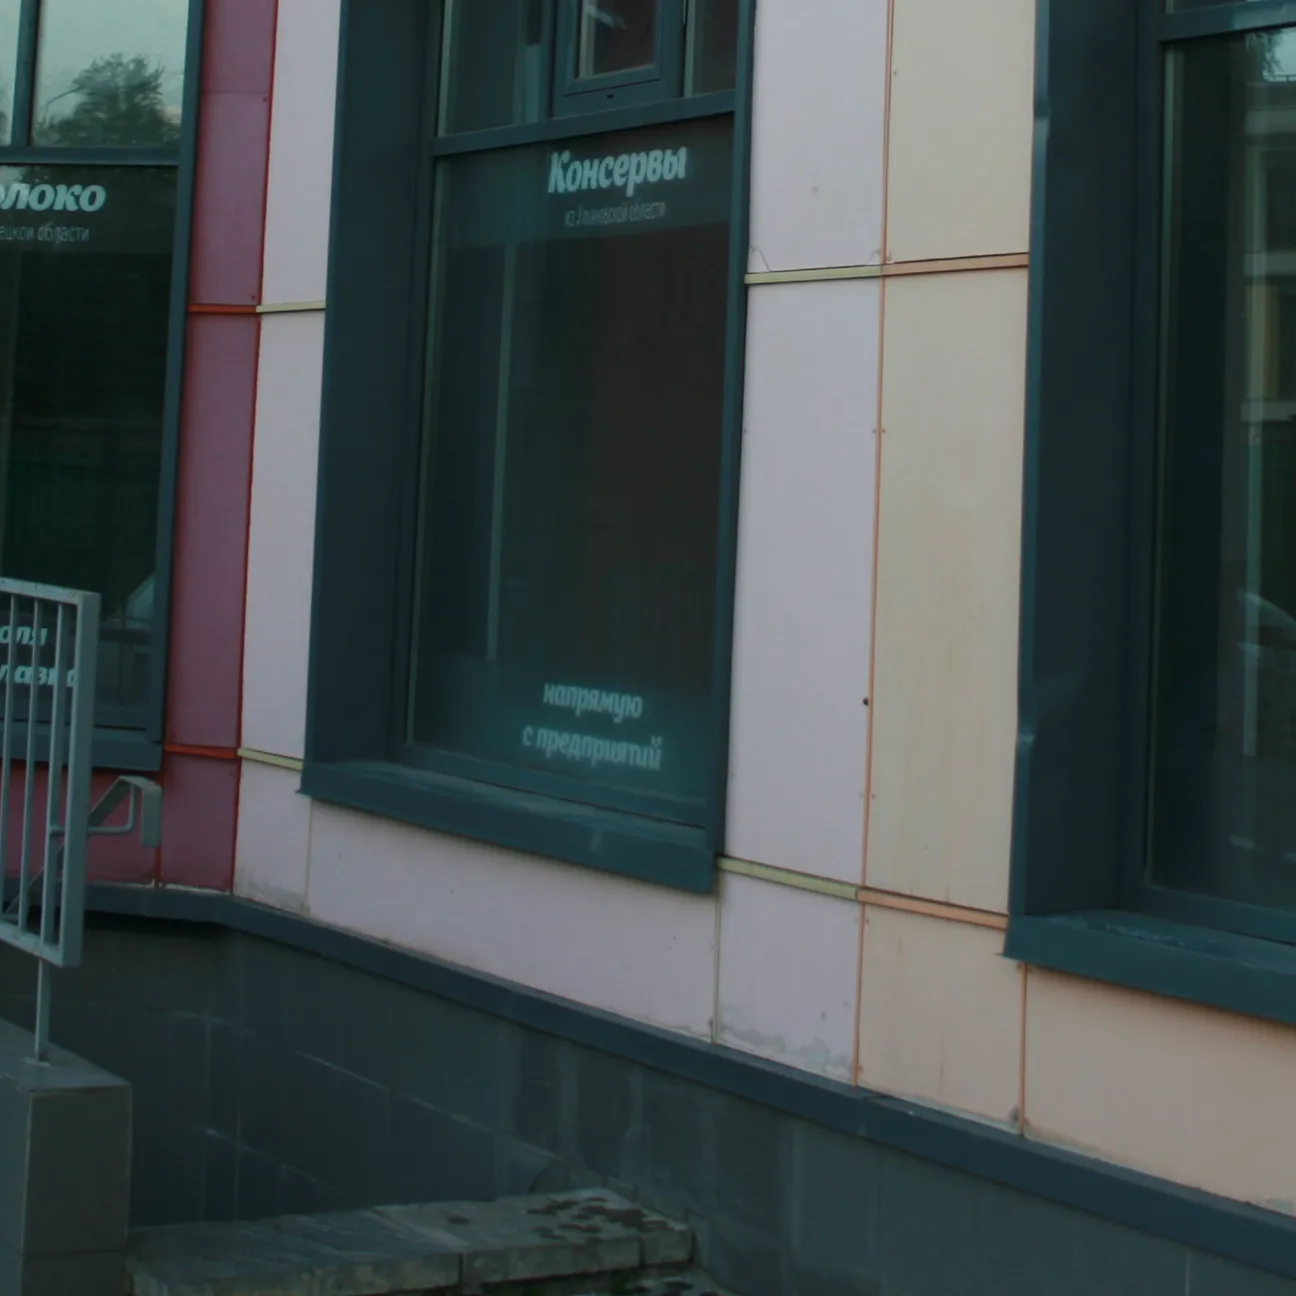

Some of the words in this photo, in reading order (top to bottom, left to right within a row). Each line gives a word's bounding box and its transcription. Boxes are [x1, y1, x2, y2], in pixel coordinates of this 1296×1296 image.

[547, 146, 687, 197] Консервы
[542, 683, 644, 724] напрямую
[522, 725, 534, 747] с
[536, 727, 664, 771] предприятий
